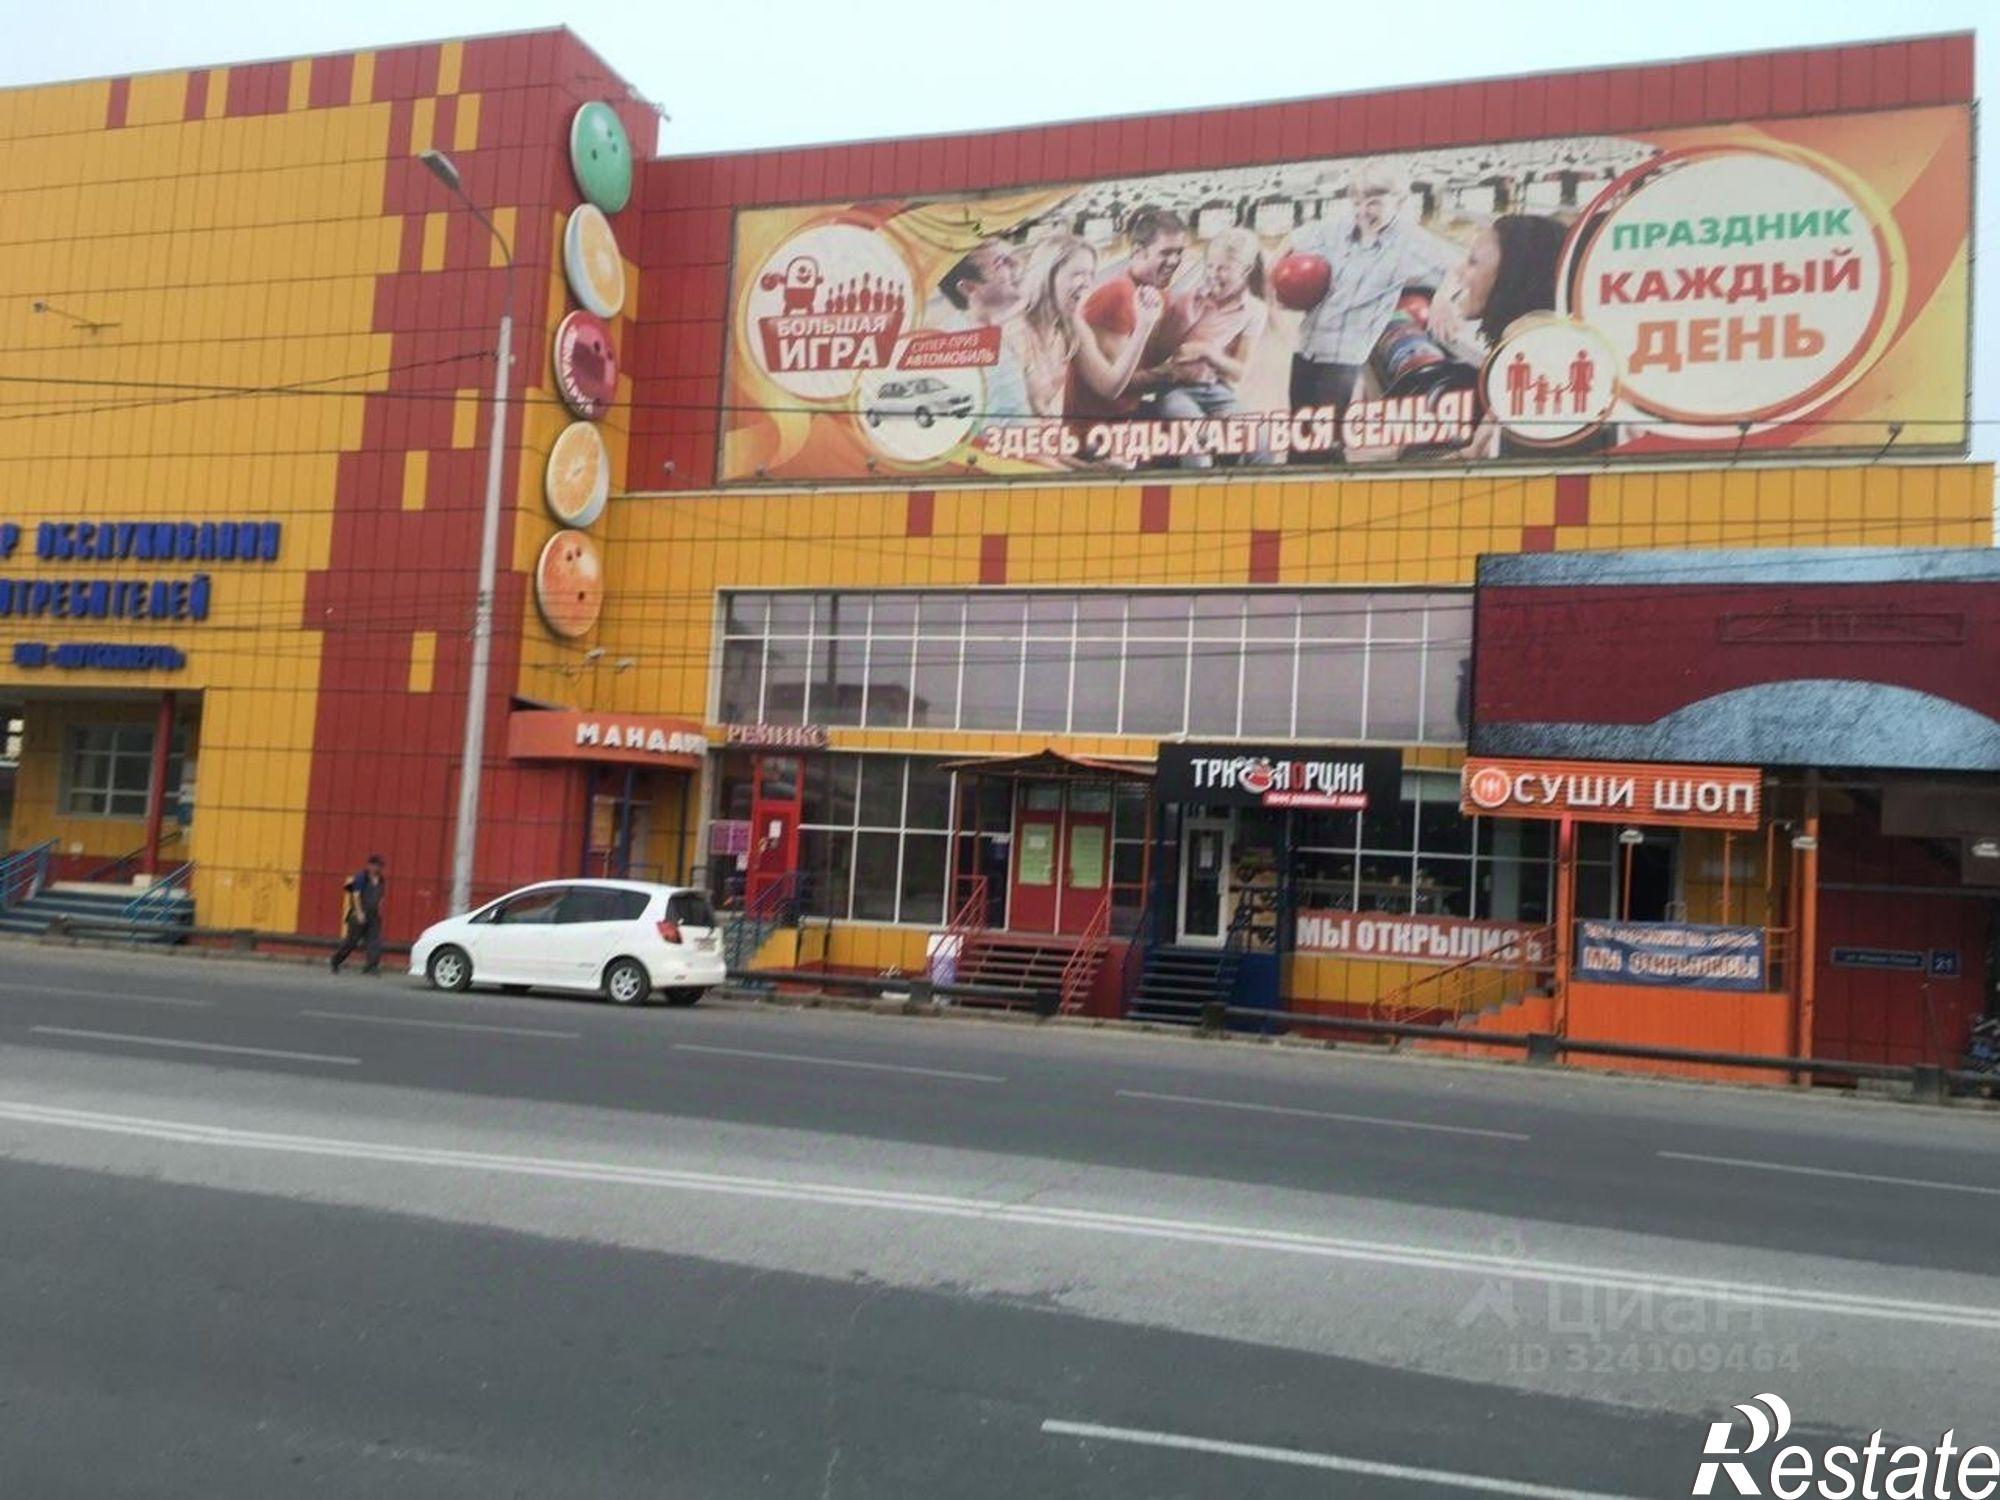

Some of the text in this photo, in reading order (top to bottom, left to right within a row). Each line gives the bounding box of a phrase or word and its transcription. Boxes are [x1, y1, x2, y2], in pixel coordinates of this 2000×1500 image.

[1612, 208, 1853, 251] ПРАЗДНИК
[1600, 247, 1863, 306] КАЖДЫЙ
[776, 313, 888, 338] БОЛЬШАЯ
[1628, 313, 1827, 375] ДЕНЬ
[778, 335, 880, 370] ИГРА
[983, 391, 1474, 463] ЗДЕСЬ ОТДЫХАЕТ ВСЯ СЕМЬЯ!
[1190, 758, 1364, 796] ТРИ ПОРЦИИ
[1513, 773, 1753, 813] СУШИ ШОП
[1297, 917, 1350, 949] МЫ
